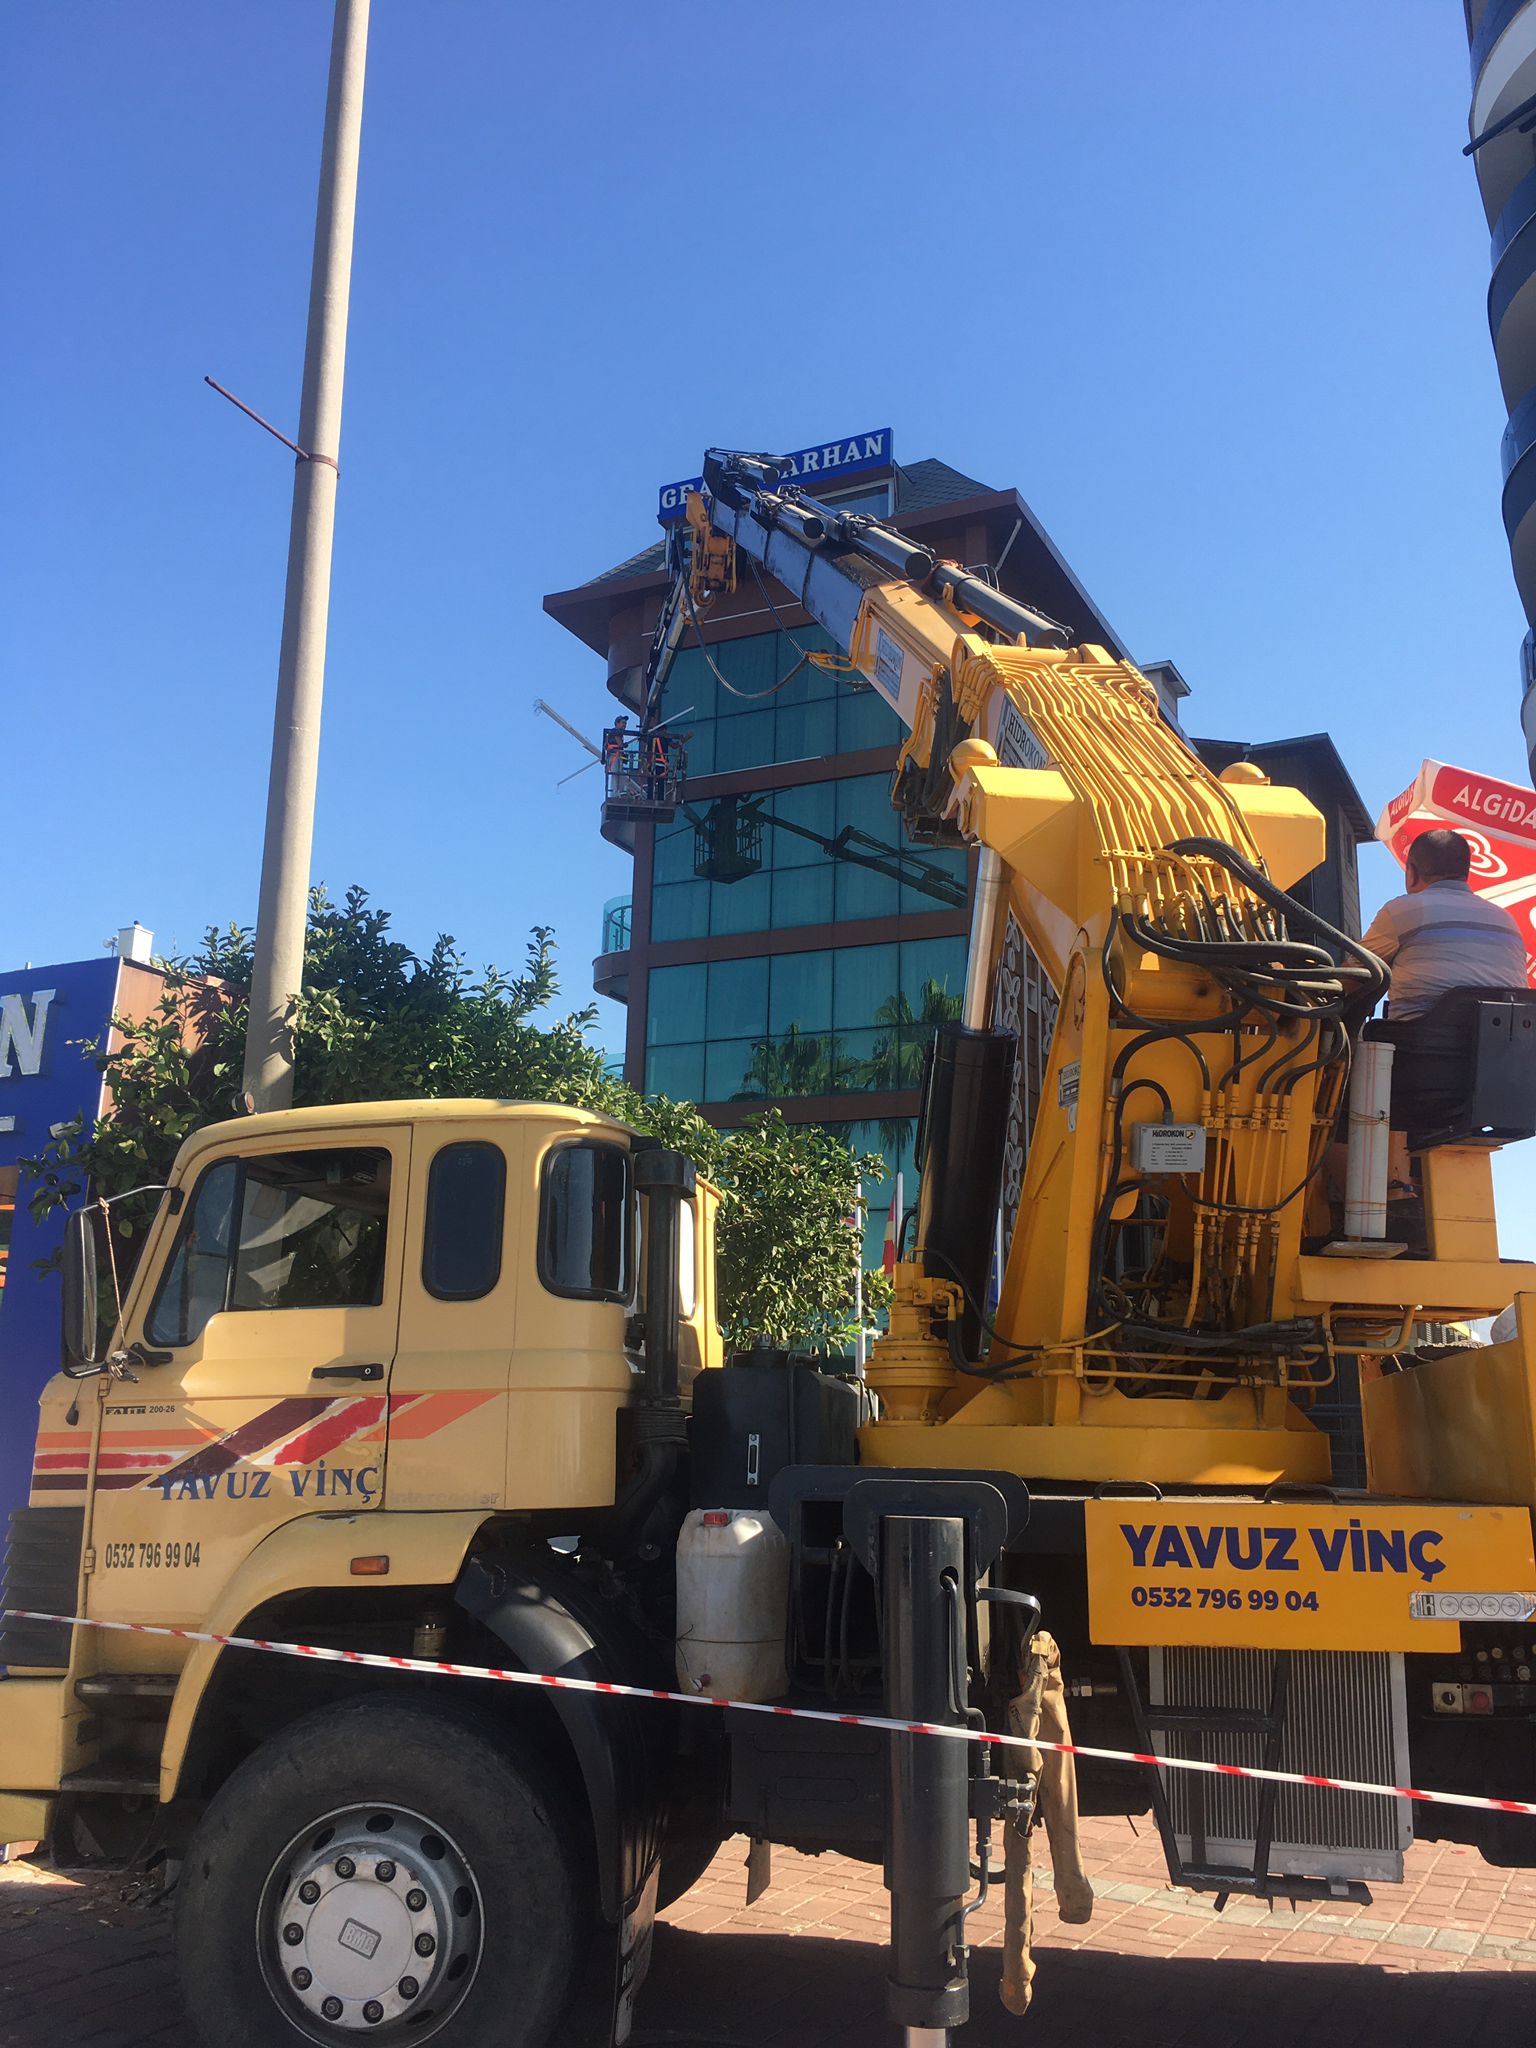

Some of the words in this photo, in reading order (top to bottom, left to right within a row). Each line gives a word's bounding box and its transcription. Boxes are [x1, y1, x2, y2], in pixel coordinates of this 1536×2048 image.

[149, 1405, 176, 1414] 200-26
[158, 1472, 272, 1500] YAVUZ
[288, 1459, 379, 1504] VİNÇ
[106, 1543, 135, 1568] 0532
[139, 1542, 161, 1568] 796
[165, 1542, 181, 1568] 99
[184, 1541, 200, 1567] 04
[1119, 1524, 1299, 1571] YAVUZ
[1308, 1518, 1447, 1583] VİNÇ
[1131, 1586, 1192, 1608] 0532
[1197, 1587, 1242, 1609] 796
[1248, 1589, 1279, 1611] 99
[1284, 1591, 1319, 1612] 04
